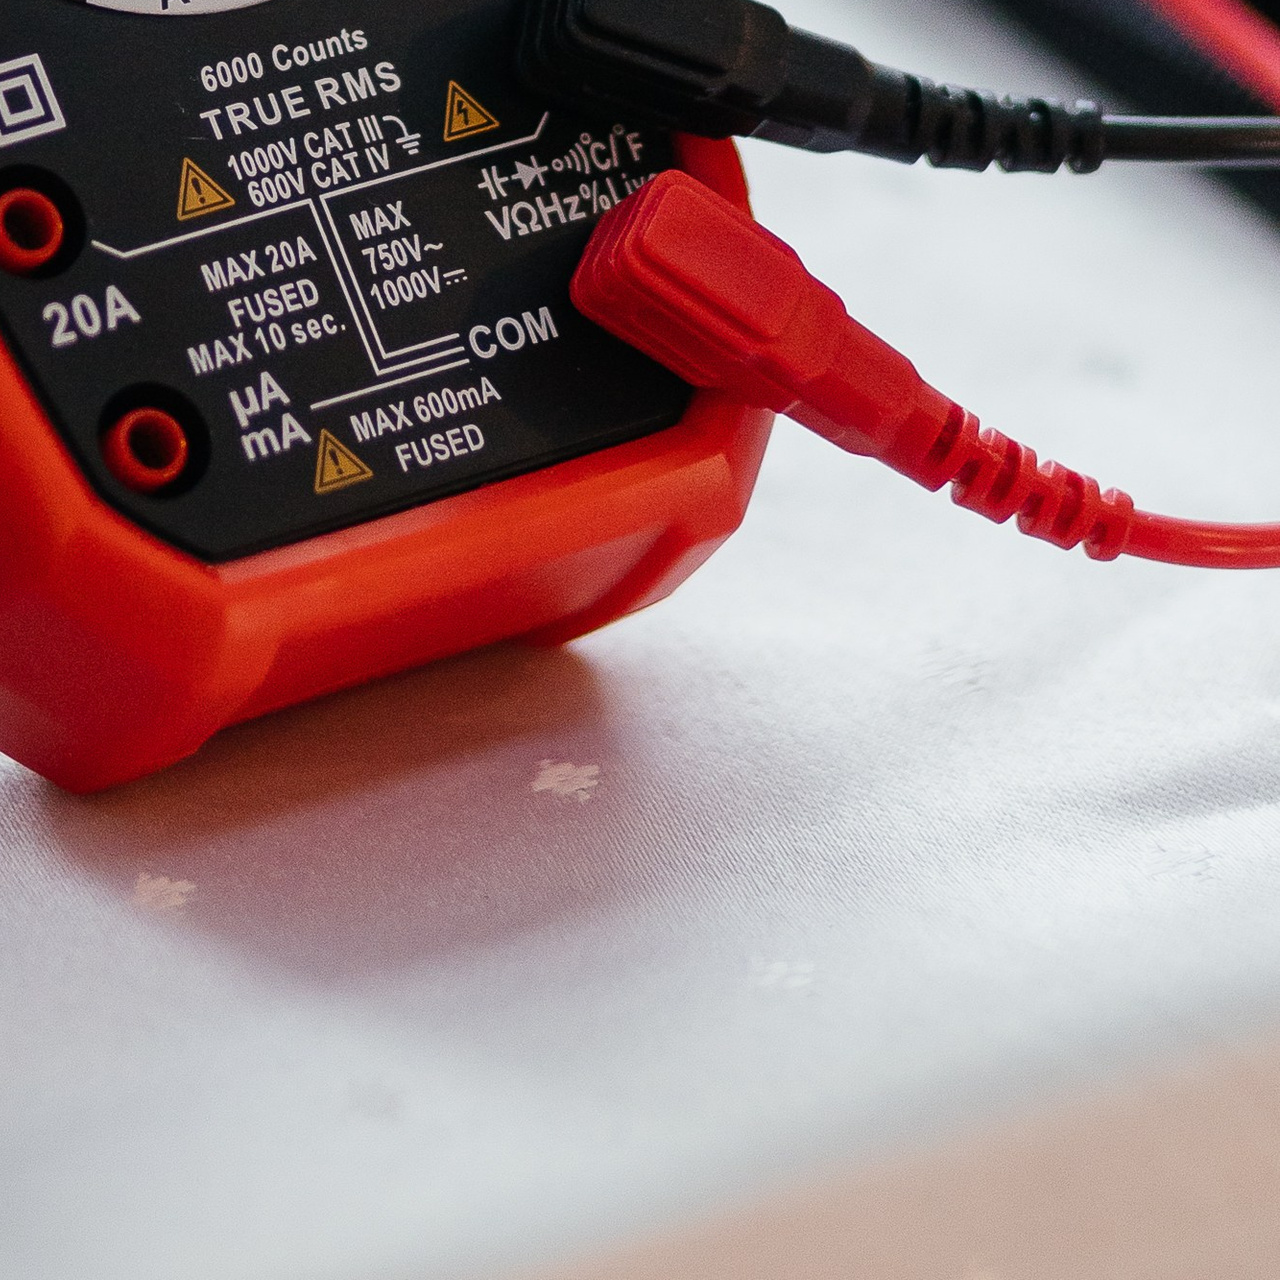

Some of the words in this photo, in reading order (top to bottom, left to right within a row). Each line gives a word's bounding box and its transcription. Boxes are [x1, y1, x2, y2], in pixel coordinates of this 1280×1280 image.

[200, 52, 263, 92] 6000
[271, 27, 368, 71] Counts
[200, 85, 311, 140] TRUE
[314, 61, 401, 110] RMS
[227, 138, 298, 181] 1000V
[305, 122, 352, 160] CAT
[357, 115, 384, 146] III
[247, 169, 306, 208] 600V
[311, 152, 358, 189] CAT
[361, 143, 391, 175] IV
[349, 201, 411, 241] MAX
[201, 252, 266, 293] MAX
[269, 236, 317, 274] 20A
[42, 284, 141, 348] 20A
[227, 278, 320, 327] FUSED
[468, 306, 560, 360] COM
[187, 337, 254, 376] MAX
[254, 324, 286, 357] 10
[292, 309, 347, 344] sec.
[239, 413, 312, 461] mA
[350, 402, 413, 443] MAX
[413, 376, 502, 424] 600mA
[395, 424, 486, 472] FUSED
